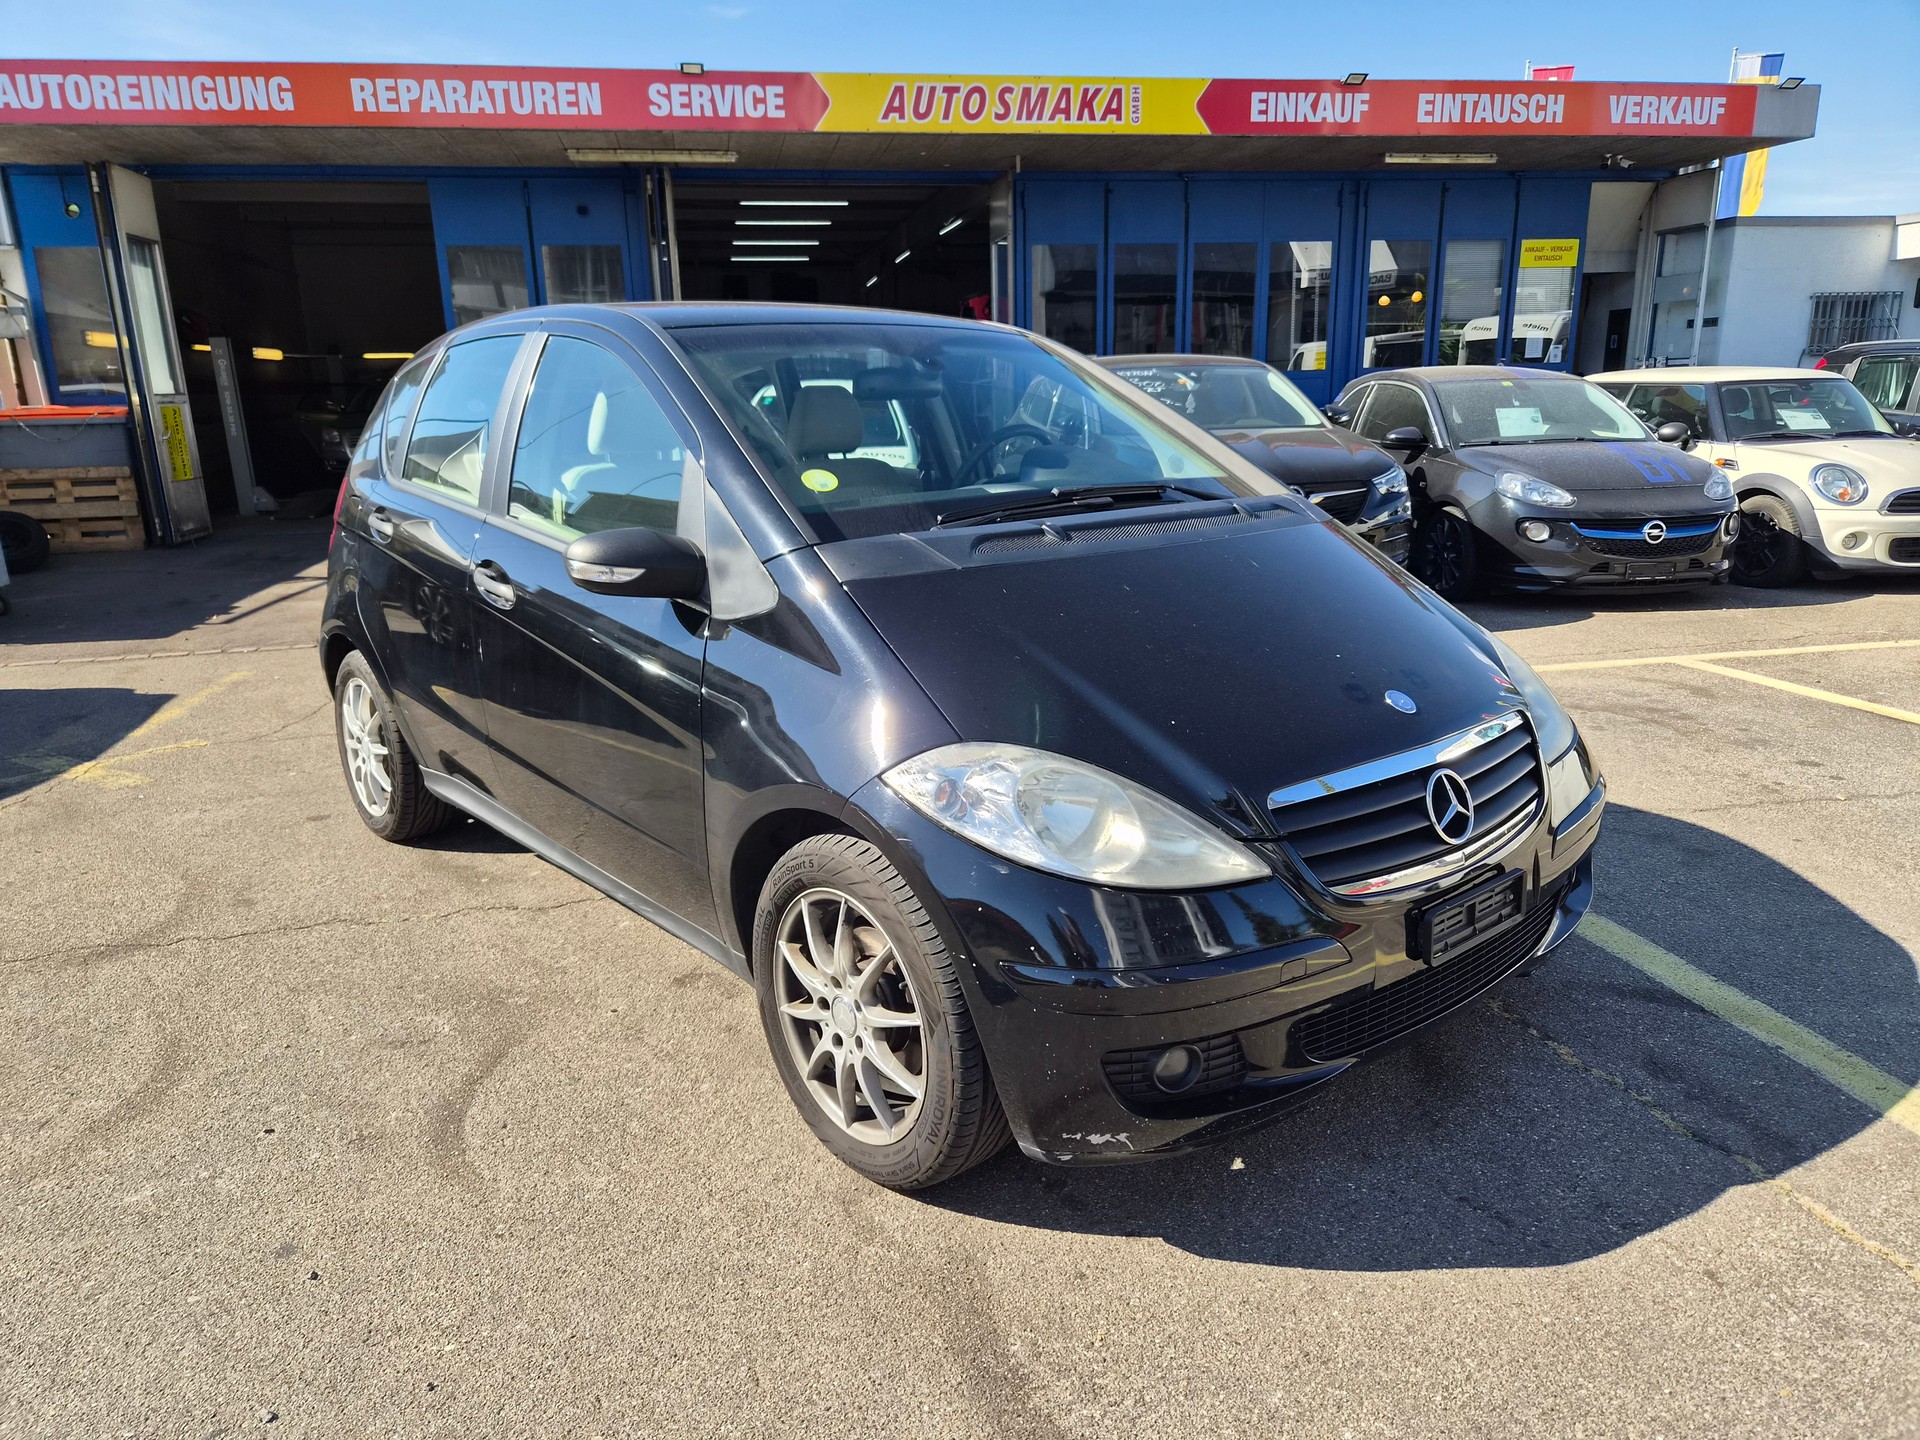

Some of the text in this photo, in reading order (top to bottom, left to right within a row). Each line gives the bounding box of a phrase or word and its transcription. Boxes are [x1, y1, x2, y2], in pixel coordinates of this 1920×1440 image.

[0, 74, 294, 111] AUTOREINIGUNG
[350, 78, 602, 116] REPARATUREN
[648, 83, 786, 118] SERVICE
[880, 84, 1124, 123] AUTO SMAKA
[1131, 86, 1140, 124] GMBH
[1250, 92, 1370, 123] EINKAUF
[1416, 93, 1566, 124] EINTAUSCH
[1609, 95, 1727, 125] VERKAUF
[1524, 245, 1546, 253] ANKAUF
[861, 452, 906, 460] AUTOS
[772, 860, 807, 888] RainSport
[808, 859, 814, 869] 5
[925, 1060, 947, 1145] UNIROYAL
